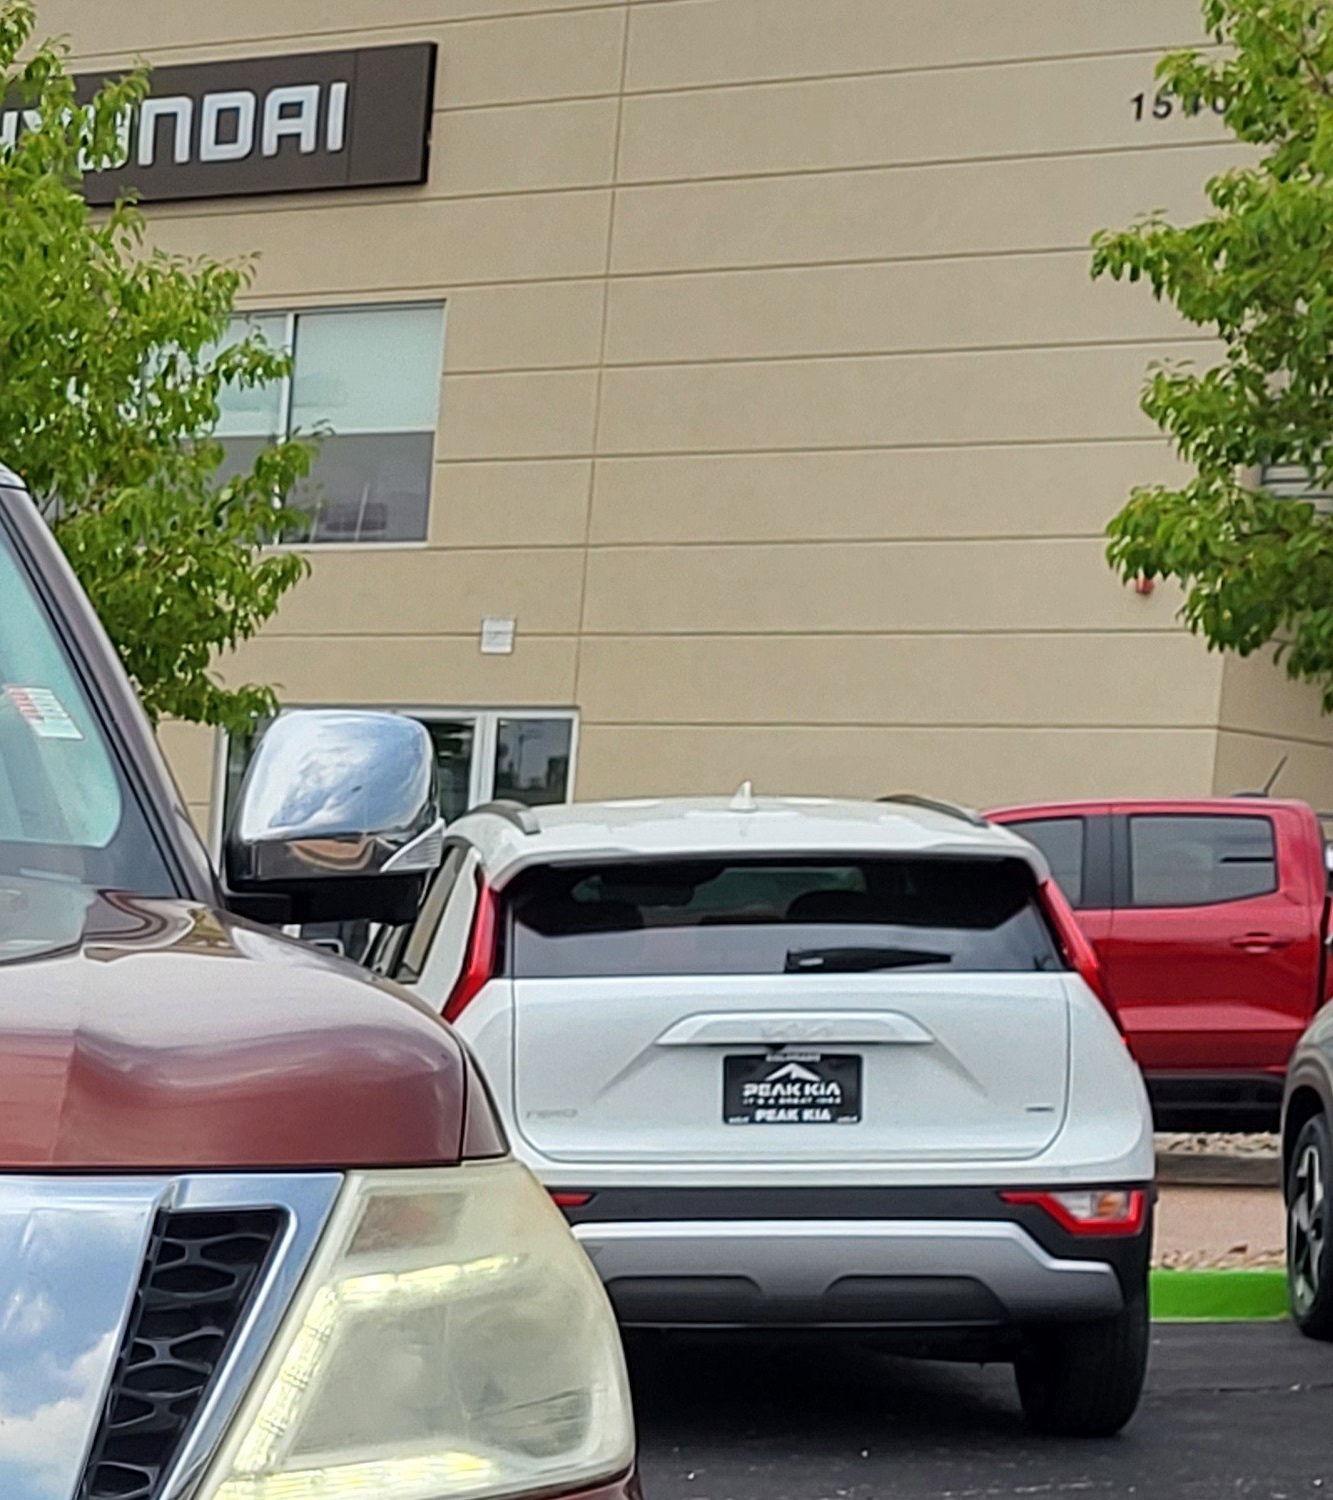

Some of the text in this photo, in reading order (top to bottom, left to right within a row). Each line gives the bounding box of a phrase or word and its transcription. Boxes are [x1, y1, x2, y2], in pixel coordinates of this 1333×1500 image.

[742, 1081, 842, 1097] PEAK KIA
[754, 1108, 799, 1122] PEAK
[802, 1108, 832, 1122] KIA
